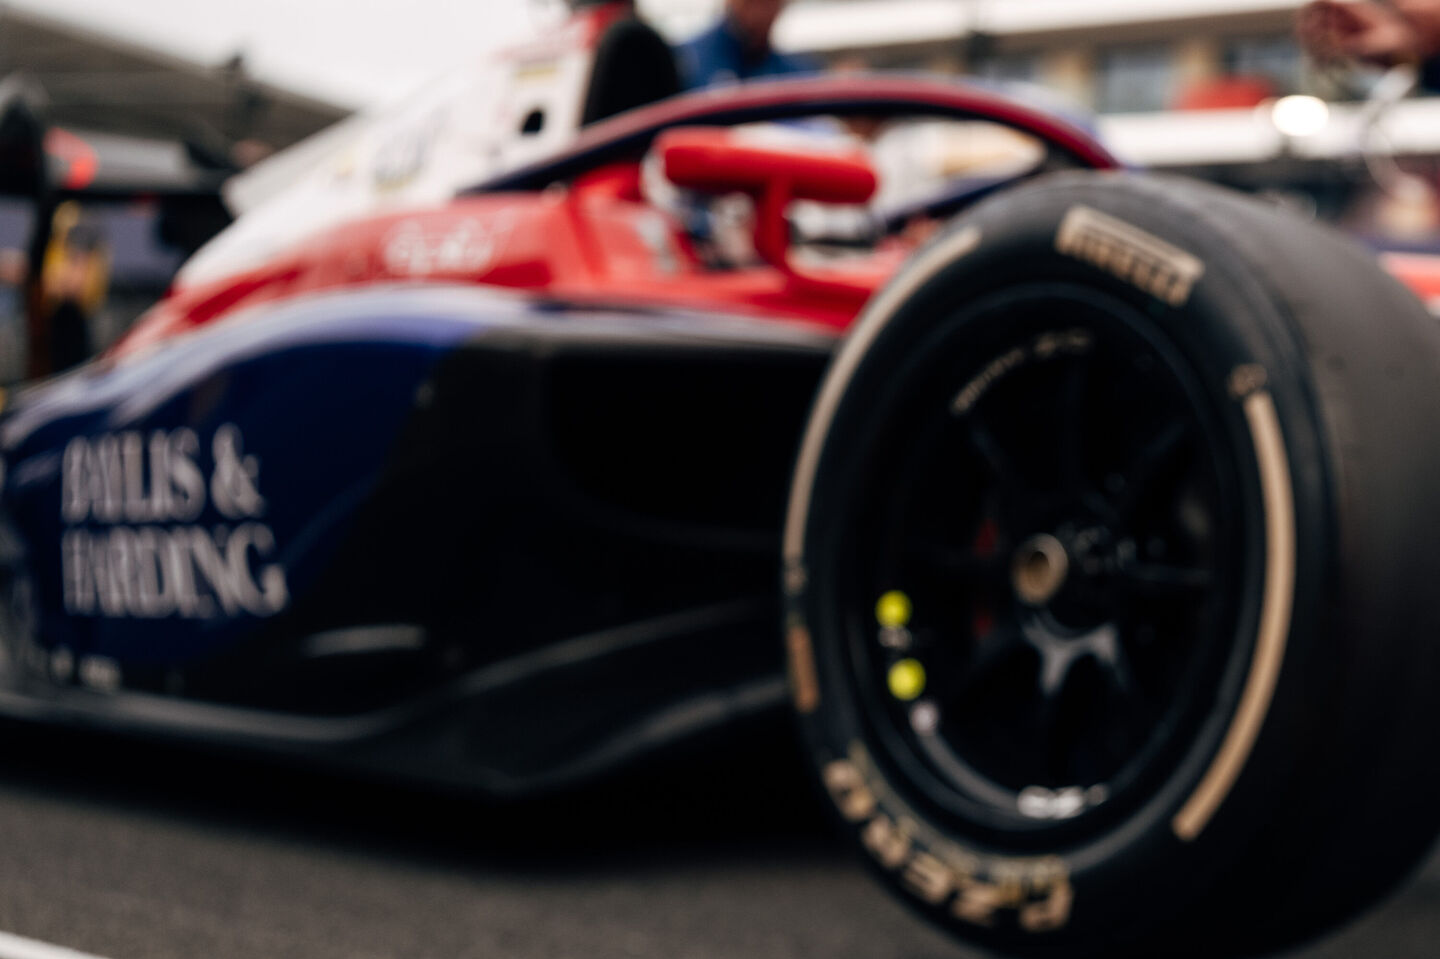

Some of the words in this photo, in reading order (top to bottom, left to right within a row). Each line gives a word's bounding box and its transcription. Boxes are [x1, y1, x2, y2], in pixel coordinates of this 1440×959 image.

[1055, 204, 1205, 308] PIRELLI
[210, 421, 267, 521] &
[62, 521, 292, 619] HARDING
